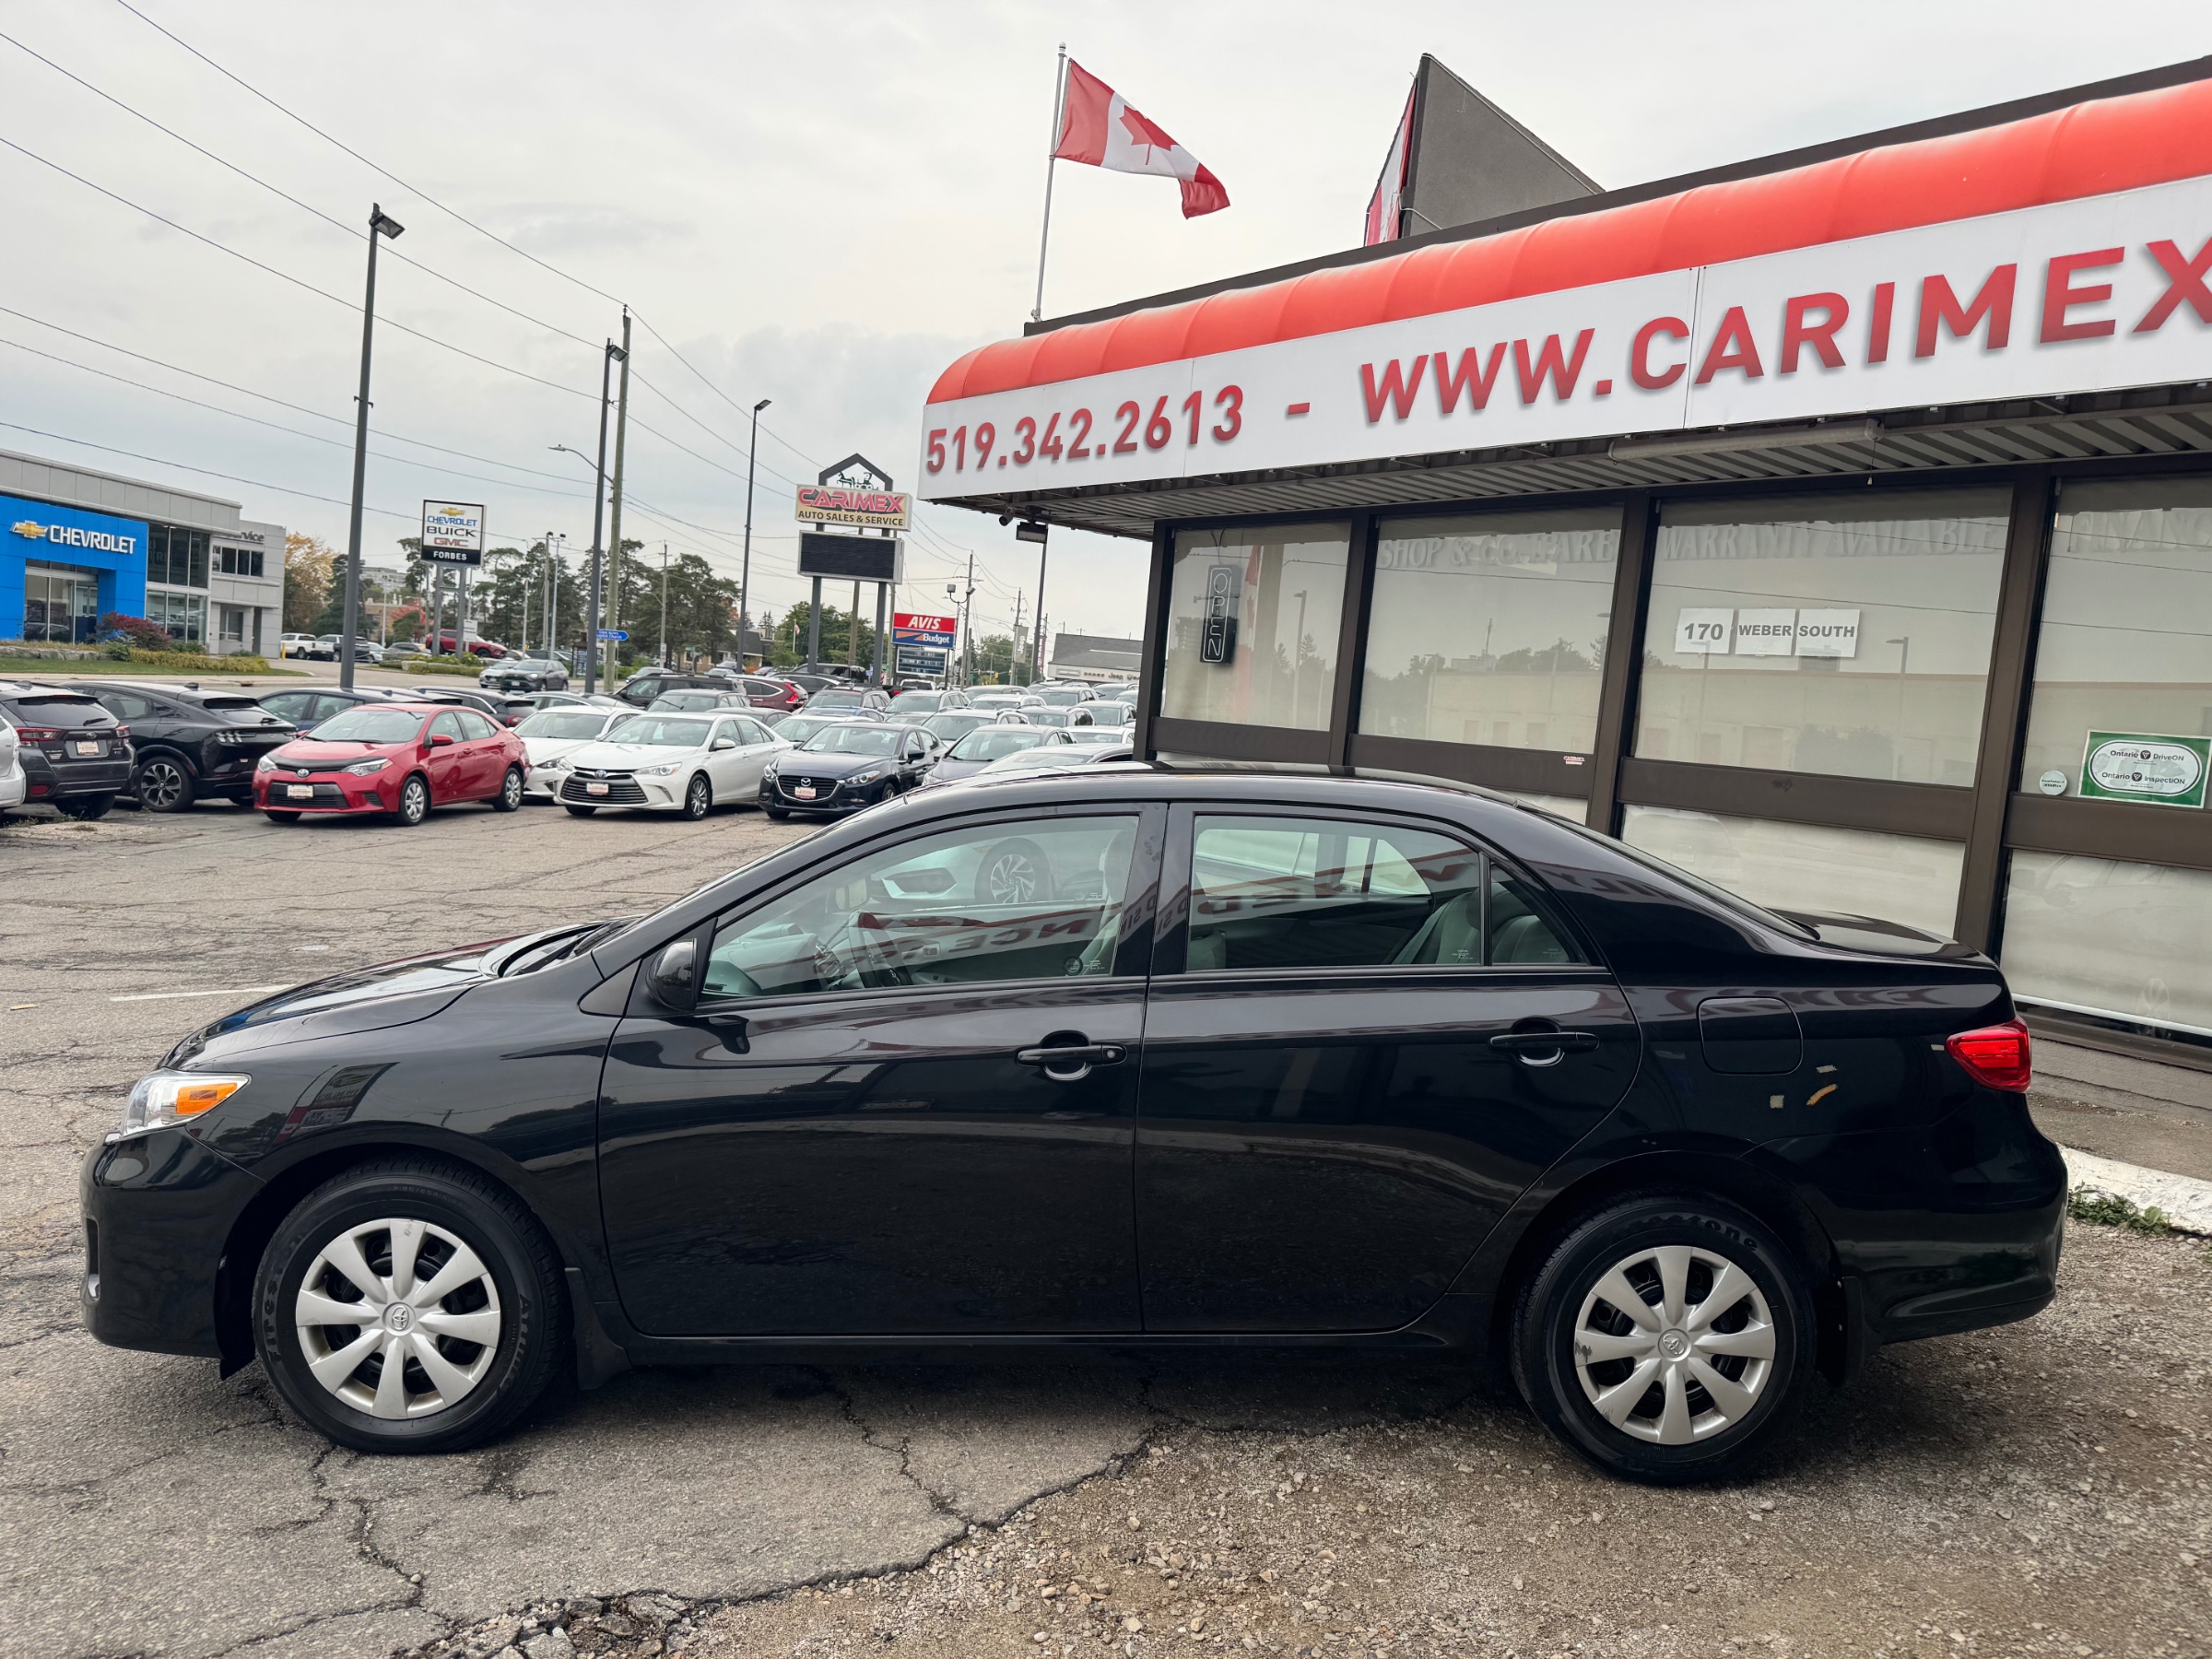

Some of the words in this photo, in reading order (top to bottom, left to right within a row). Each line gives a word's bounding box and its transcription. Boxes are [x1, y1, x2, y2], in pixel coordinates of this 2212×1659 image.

[926, 384, 1244, 474] 519.342.2613
[1360, 237, 2212, 424] WWW.CARIMEX
[798, 488, 904, 512] CARIMEX
[427, 515, 477, 527] CHEVROLET
[798, 511, 824, 520] AUTO
[826, 512, 854, 523] SALES
[865, 516, 903, 526] SERVICE
[426, 525, 477, 537] BUICK
[50, 524, 136, 555] CHEVROLET
[434, 536, 469, 547] GMC
[433, 550, 467, 561] FORBES
[1206, 571, 1230, 657] OPEN
[907, 616, 942, 630] AVIS
[923, 633, 950, 644] Budget
[1684, 623, 1724, 641] 170
[1738, 624, 1792, 637] WEBER
[1798, 625, 1855, 638] SOUTH
[2110, 749, 2138, 759] Ontario
[2153, 753, 2184, 761] DriveON
[2101, 771, 2131, 780] Ontario
